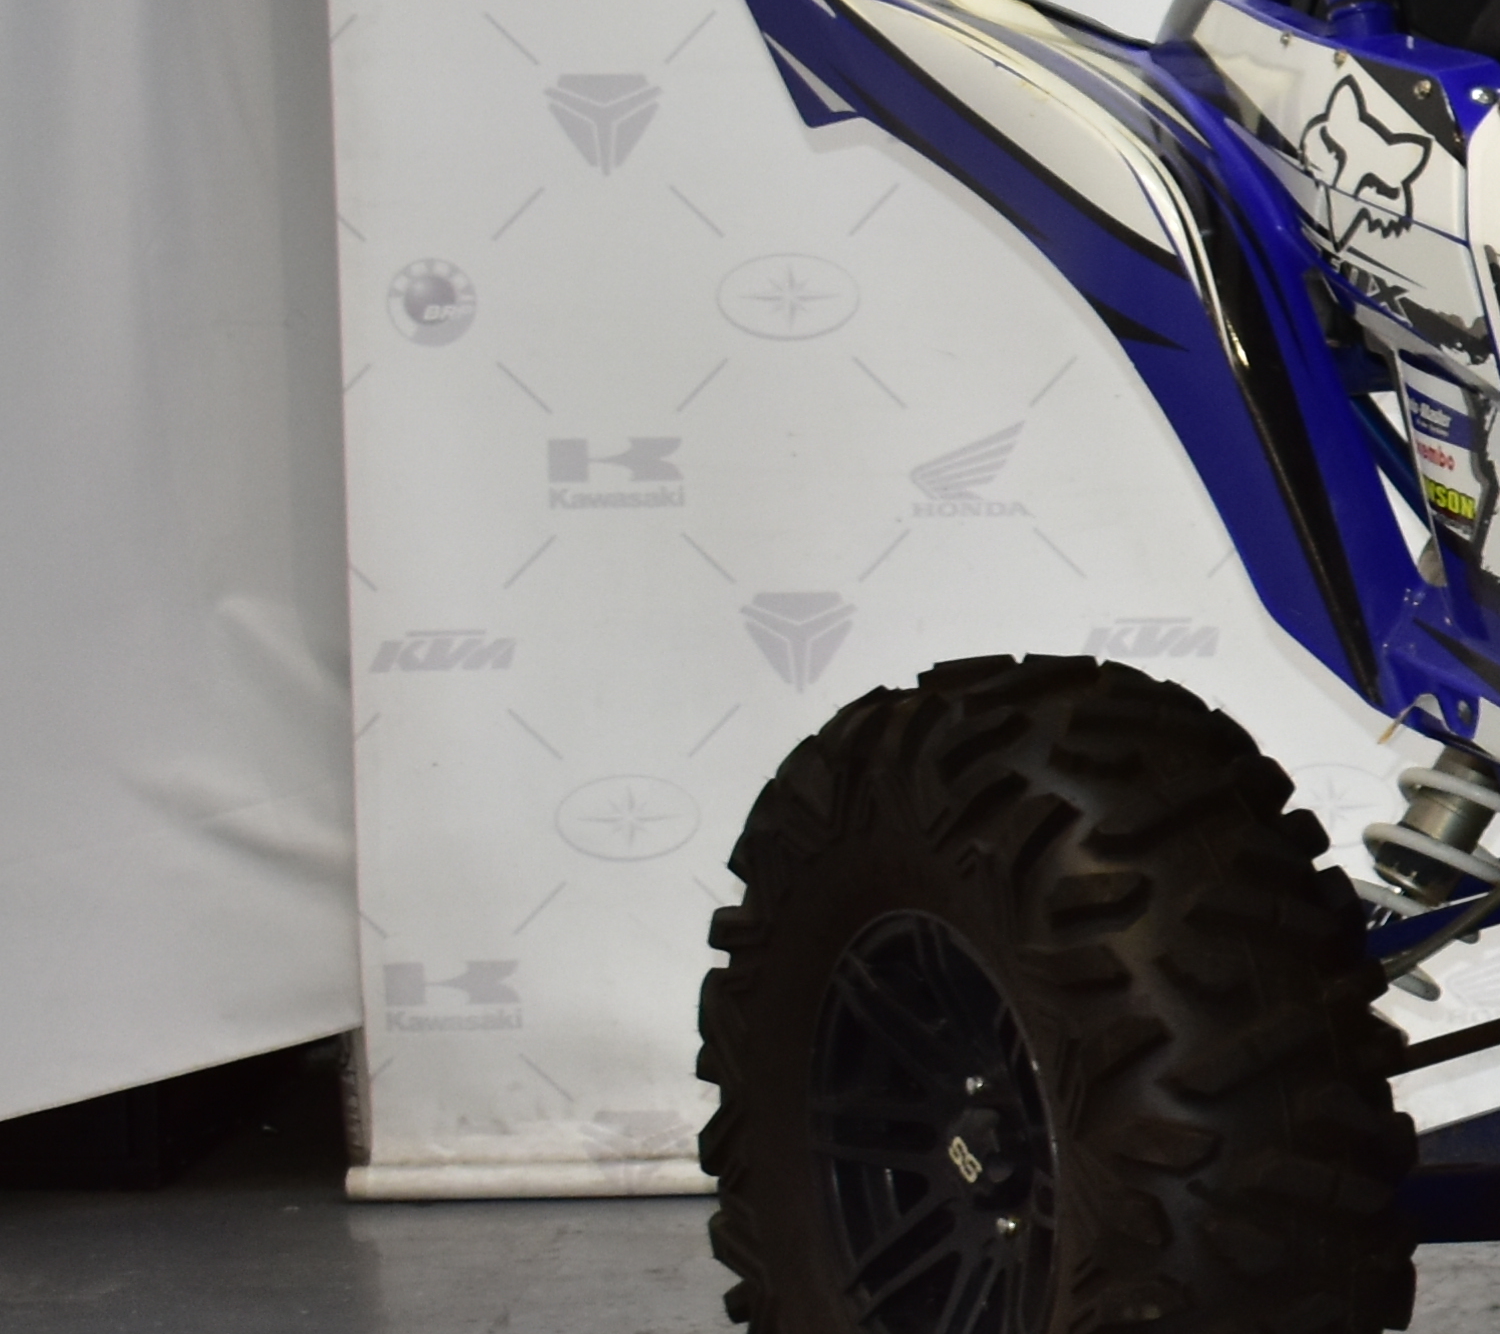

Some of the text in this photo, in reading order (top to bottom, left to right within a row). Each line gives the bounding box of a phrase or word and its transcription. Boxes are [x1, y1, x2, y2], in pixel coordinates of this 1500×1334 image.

[548, 487, 686, 511] Kawasaki
[912, 502, 1030, 518] HONDA
[1082, 618, 1219, 657] KTM
[370, 628, 517, 673] KTM
[386, 1009, 524, 1032] Kawasaki
